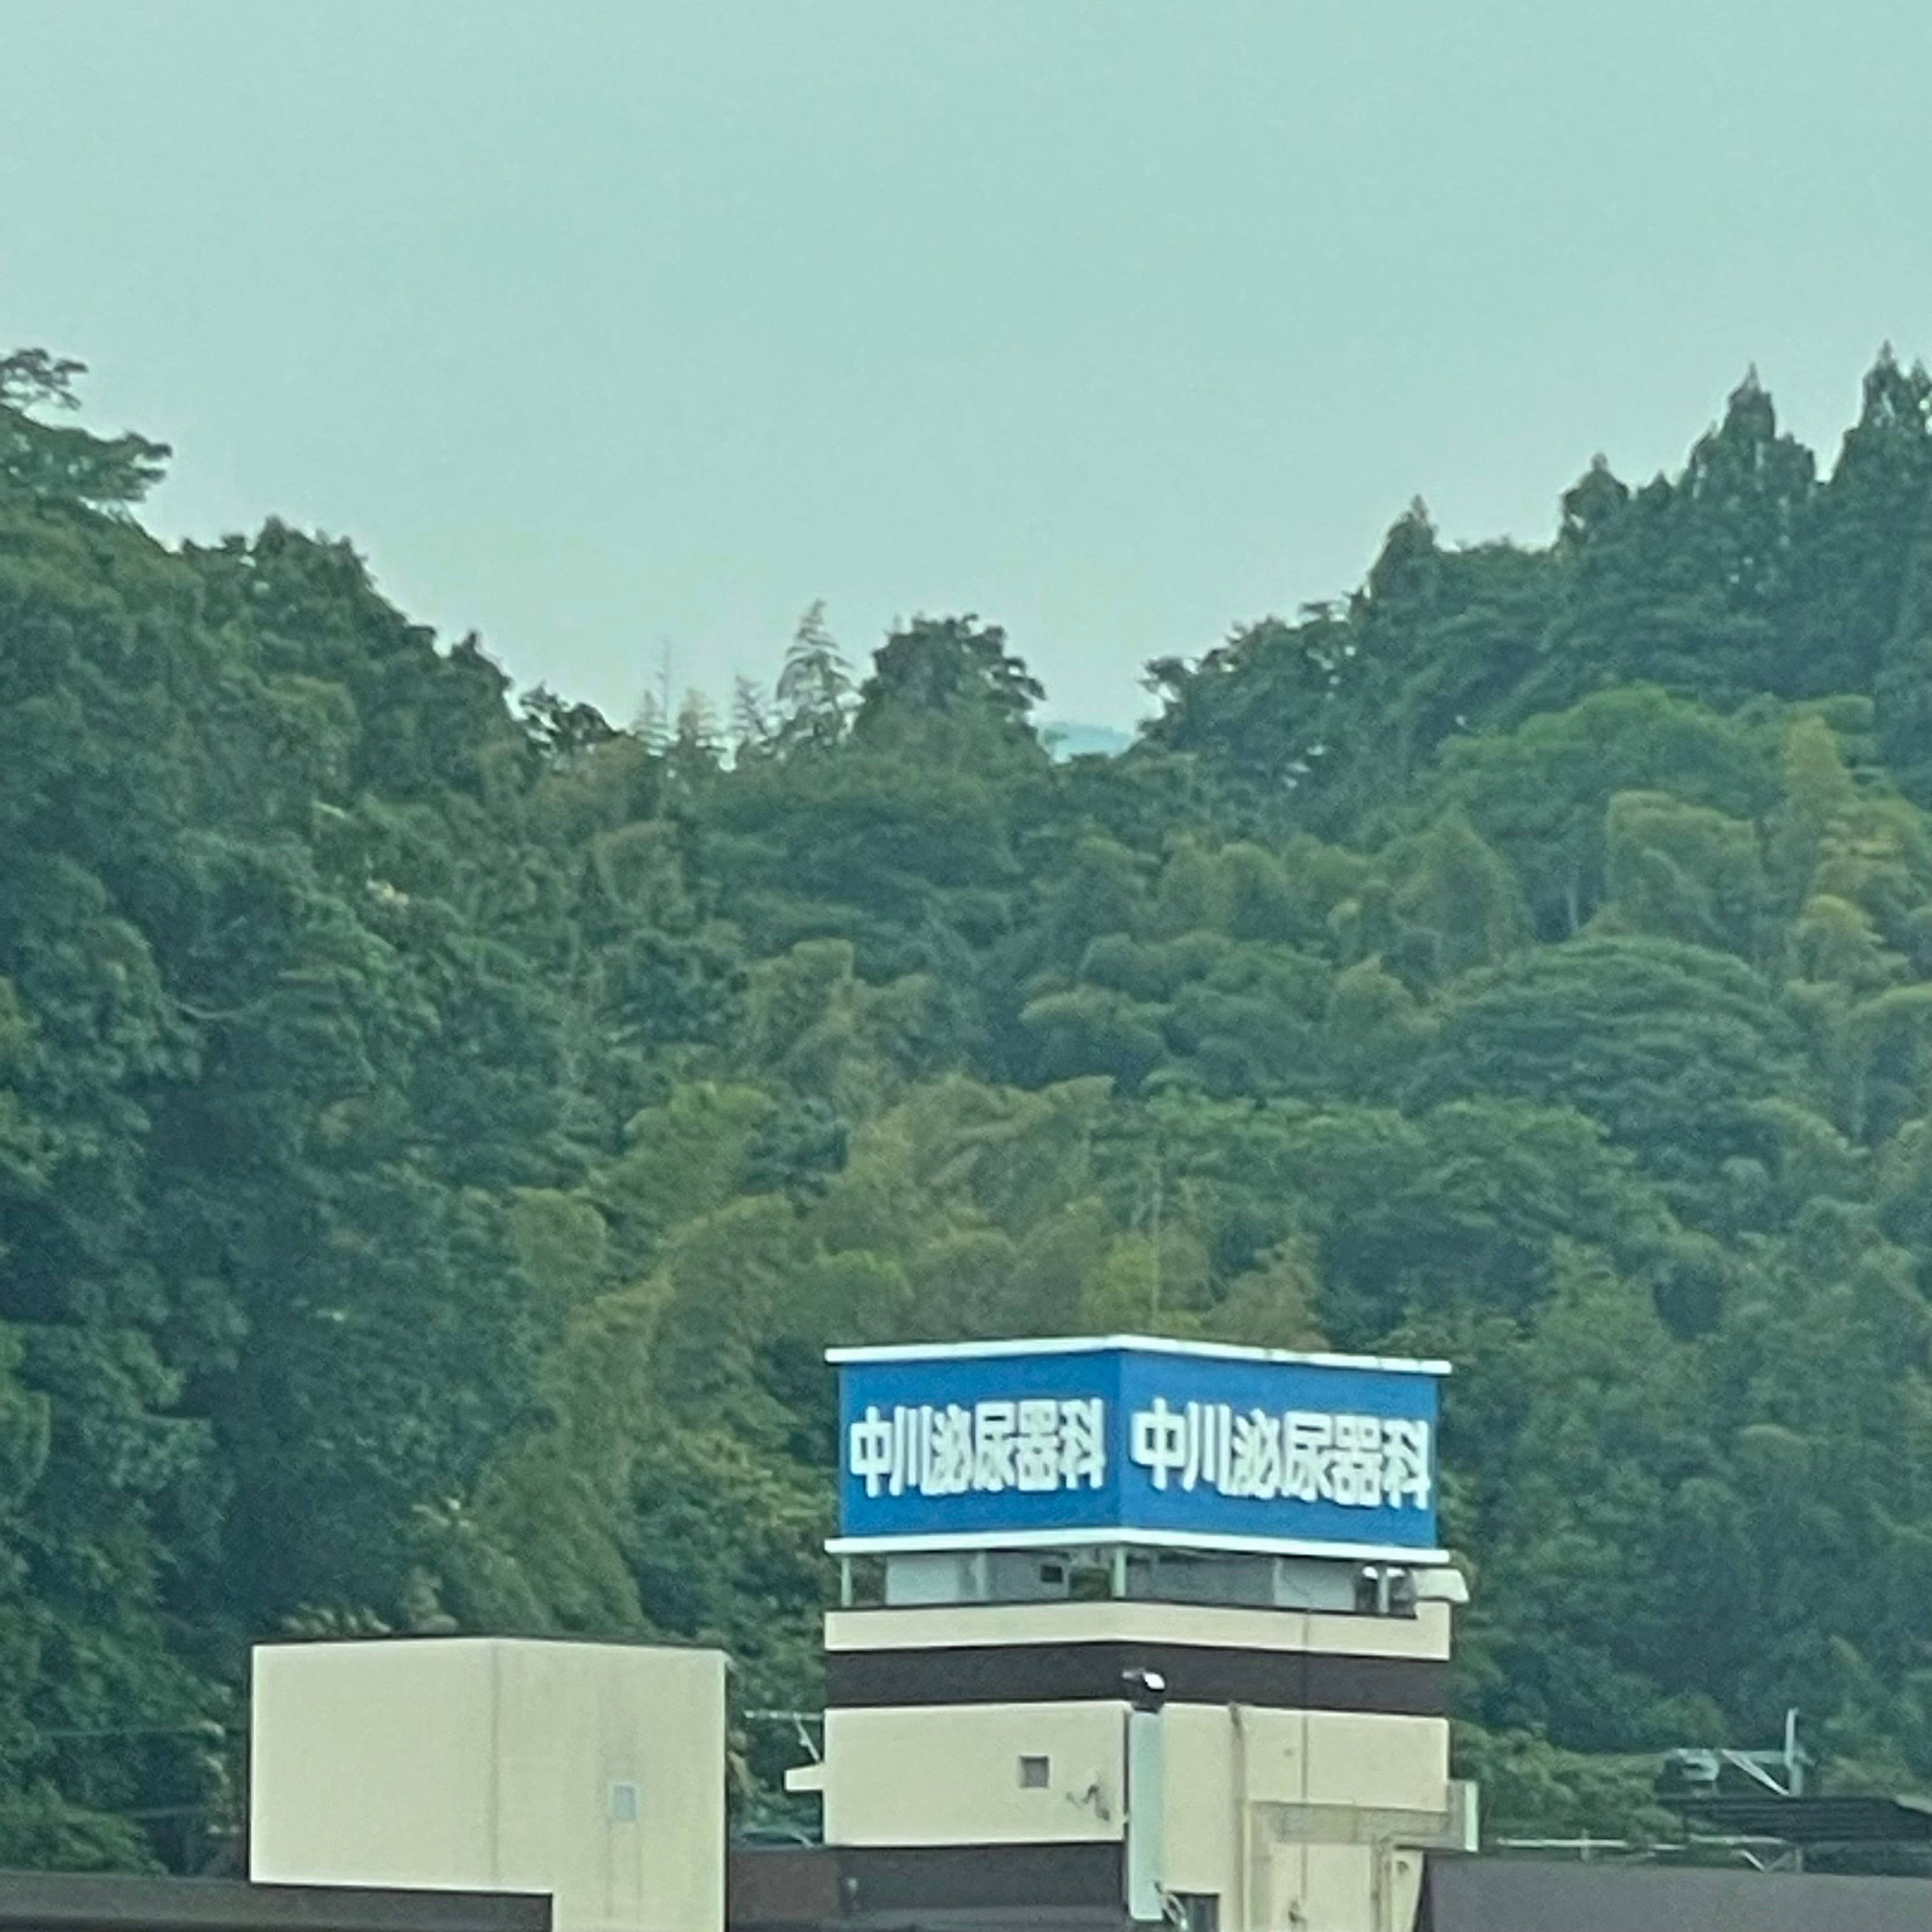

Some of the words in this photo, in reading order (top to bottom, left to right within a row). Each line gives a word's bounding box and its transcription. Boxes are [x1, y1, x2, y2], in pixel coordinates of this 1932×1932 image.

[850, 1398, 1106, 1497] 中川泌尿器科
[1131, 1397, 1431, 1509] 中川泌尿器科
